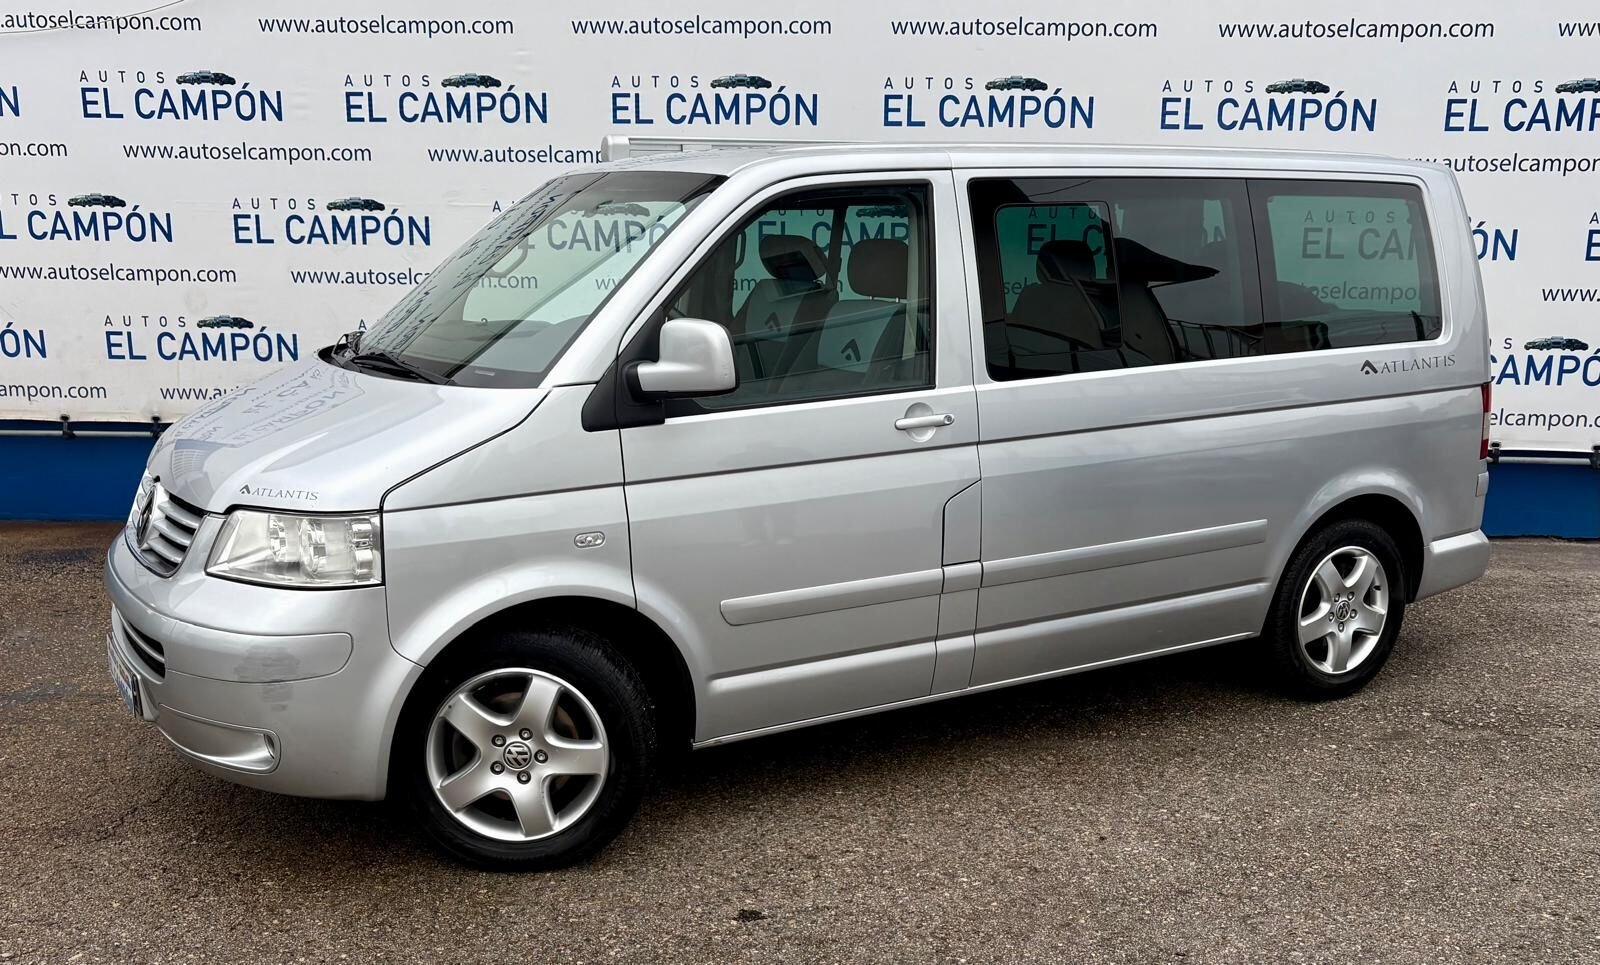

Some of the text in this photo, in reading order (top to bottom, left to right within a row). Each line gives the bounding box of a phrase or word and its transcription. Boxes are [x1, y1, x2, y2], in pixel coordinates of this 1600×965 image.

[0, 9, 202, 35] .autoselcampon.com
[258, 14, 514, 39] www.autoselcampon.com
[571, 14, 832, 39] www.autoselcampon.com
[891, 16, 1158, 42] www.autoselcampon.com
[1218, 17, 1495, 43] www.autoselcampon.com
[79, 70, 165, 84] AUTOS
[344, 74, 430, 88] AUTOS
[611, 75, 699, 89] AUTOS
[883, 76, 974, 90] AUTOS
[1162, 79, 1254, 94] AUTOS
[1447, 80, 1543, 94] AUTOS
[80, 82, 283, 122] EL CAMPÓN
[345, 84, 548, 124] EL CAMPÓN
[611, 85, 818, 126] EL CAMPÓN
[883, 87, 1095, 129] EL CAMPÓN
[1160, 90, 1377, 132] EL CAMPÓN
[1443, 98, 1489, 132] EL
[122, 141, 372, 166] www.autoselcampon.com
[232, 197, 316, 211] AUTOS
[27, 204, 173, 243] CAMPÓN
[232, 208, 431, 246] EL CAMPÓN
[1302, 227, 1345, 259] EL
[104, 314, 186, 328] AUTOS
[105, 325, 299, 363] EL CAMPÓN
[1380, 353, 1457, 376] ATLANTIS
[251, 486, 319, 501] ATLANTIS
